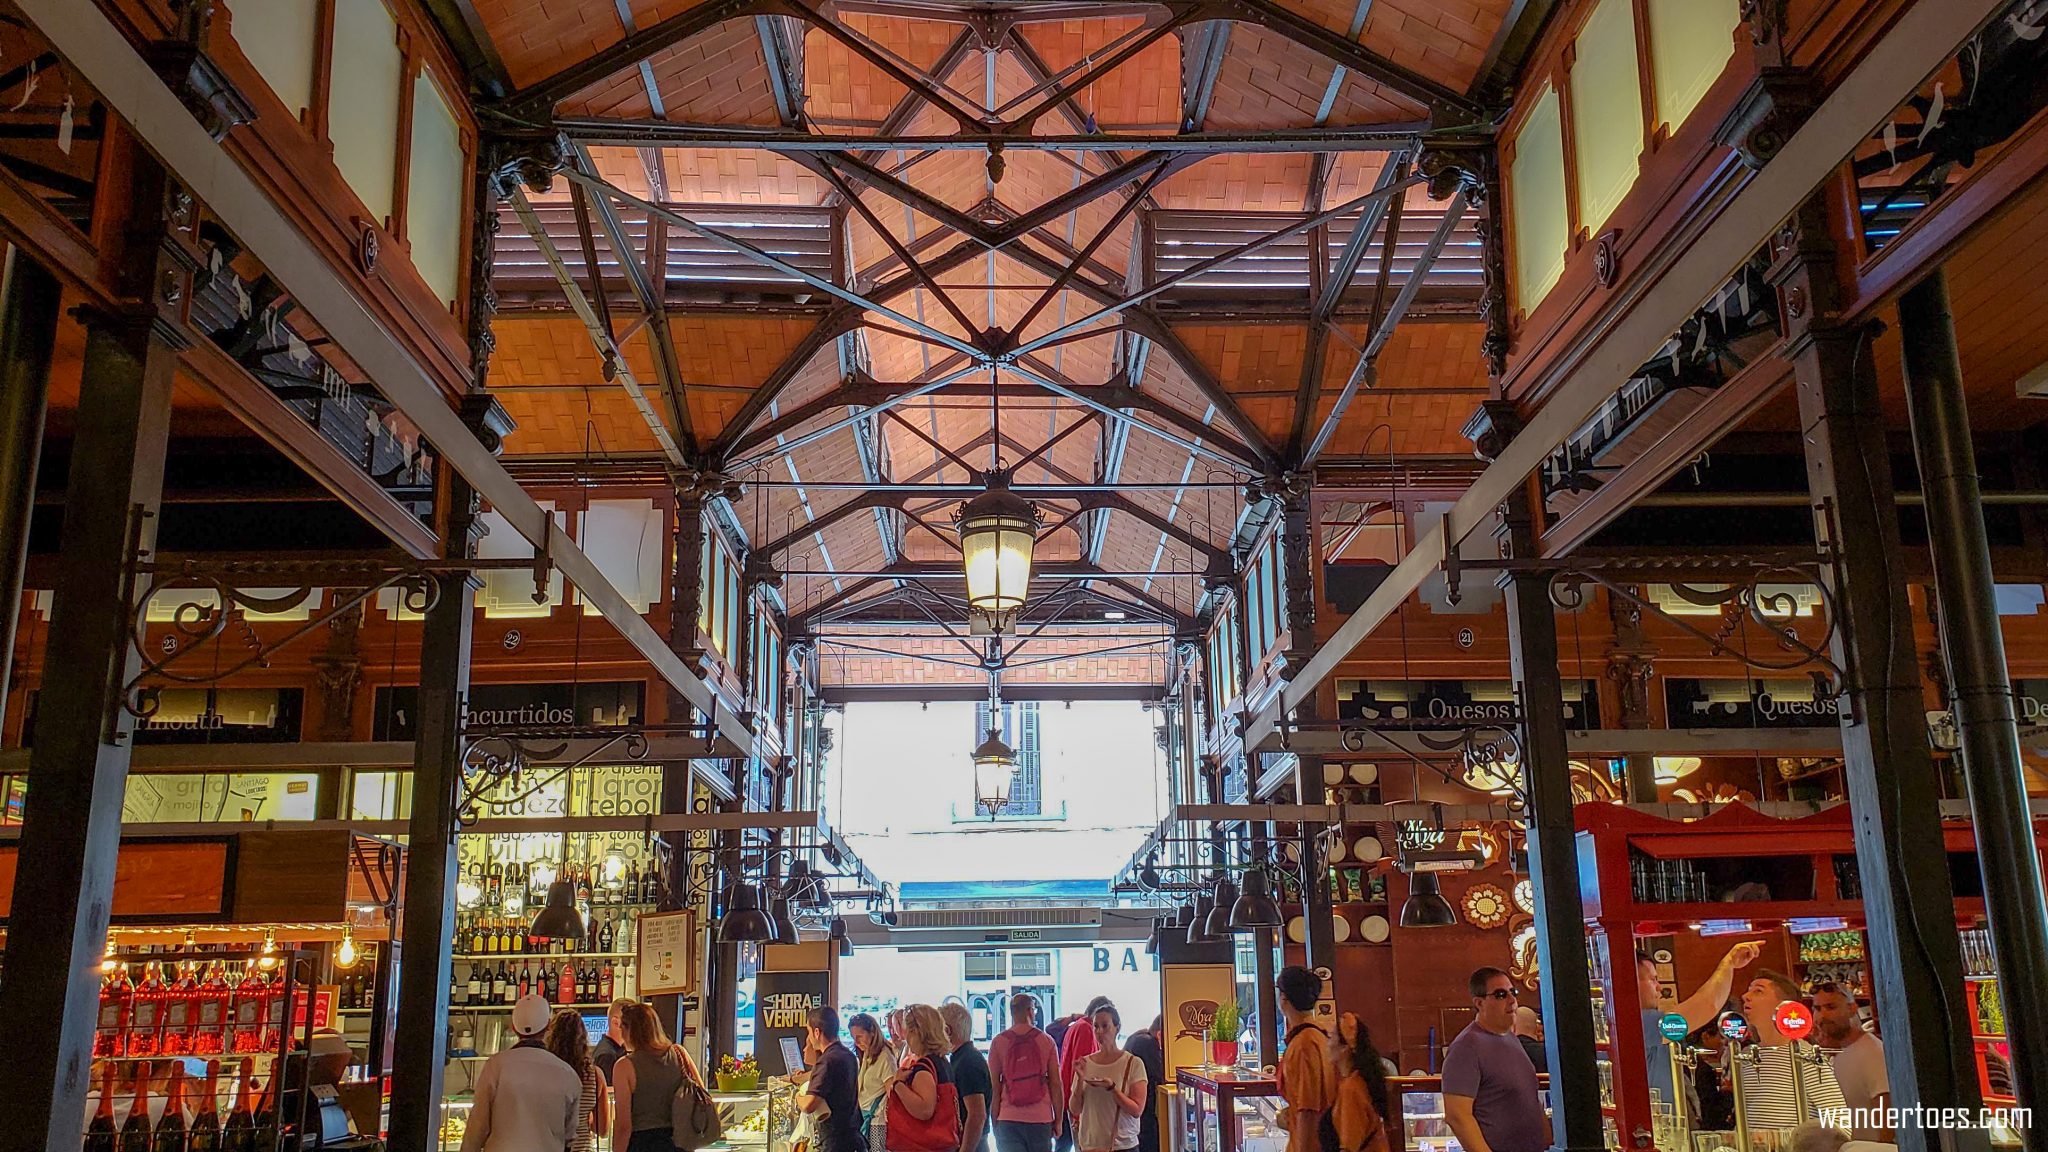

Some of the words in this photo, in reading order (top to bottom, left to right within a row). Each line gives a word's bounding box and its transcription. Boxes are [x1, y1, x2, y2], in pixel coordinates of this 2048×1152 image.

[163, 636, 177, 649] 23
[506, 633, 519, 647] 22
[1460, 631, 1473, 645] 21
[466, 702, 573, 725] ncurtidos
[1428, 697, 1510, 719] Quesos
[1757, 693, 1838, 721] Quesos
[2019, 696, 2048, 718] De
[133, 707, 224, 731] rmouth
[1013, 931, 1040, 939] SALIDA
[775, 993, 812, 1010] HORA
[763, 1009, 807, 1028] VERMU
